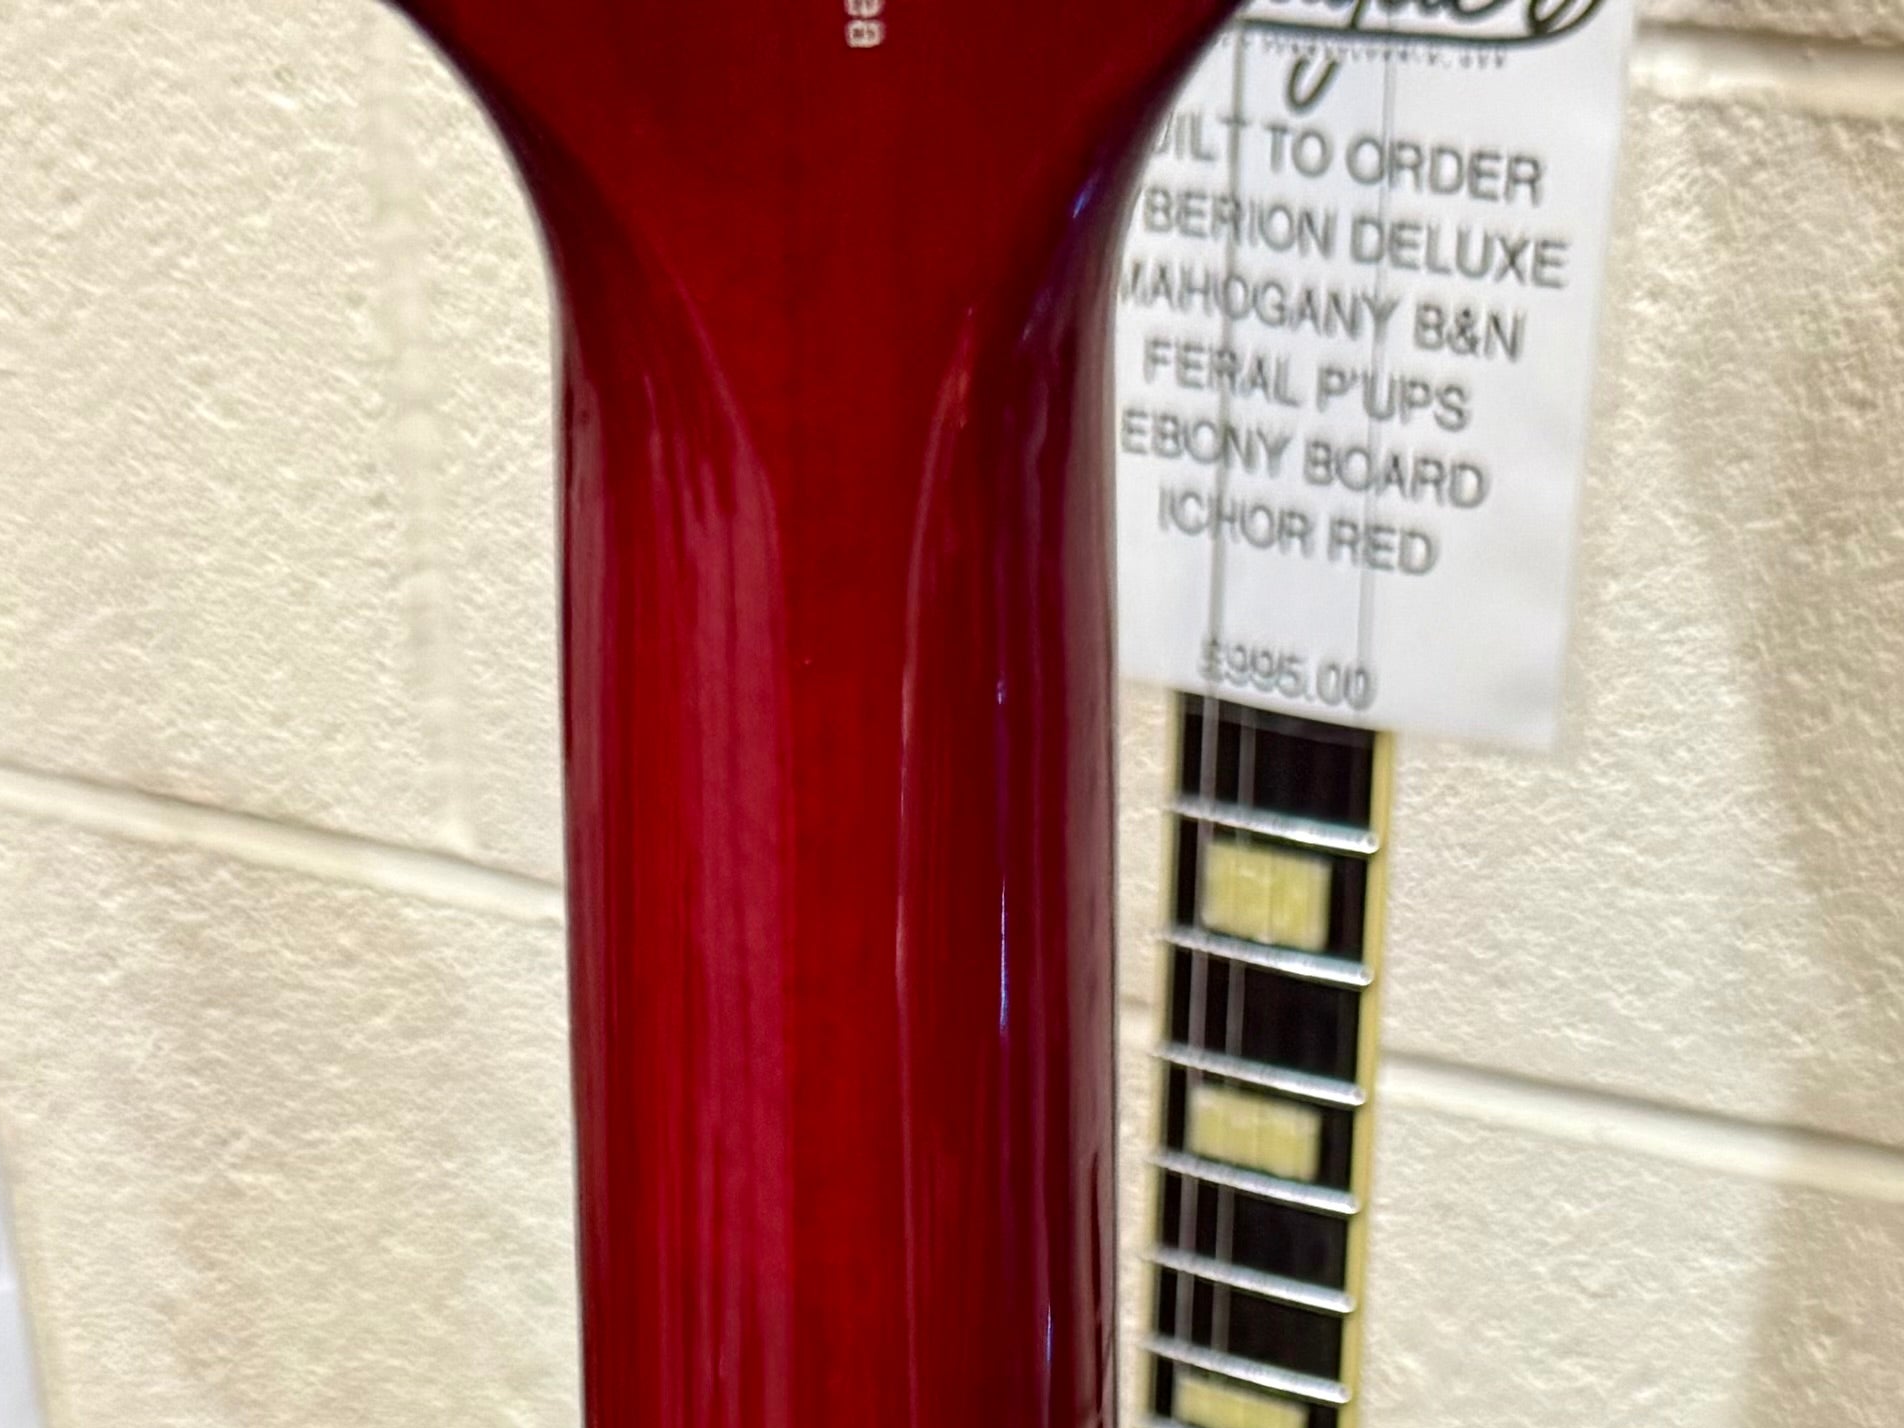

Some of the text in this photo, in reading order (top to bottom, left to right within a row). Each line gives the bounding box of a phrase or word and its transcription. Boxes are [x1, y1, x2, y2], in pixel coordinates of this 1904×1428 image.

[1263, 121, 1333, 178] TO
[1344, 134, 1546, 204] ORDER
[1142, 185, 1572, 288] BERION DELUXE
[1120, 258, 1526, 362] MAHOGANY B&N
[1143, 338, 1472, 432] FERAL P'UPS
[1121, 408, 1492, 509] EBONY BOARD
[1158, 484, 1440, 576] ICHOR RED
